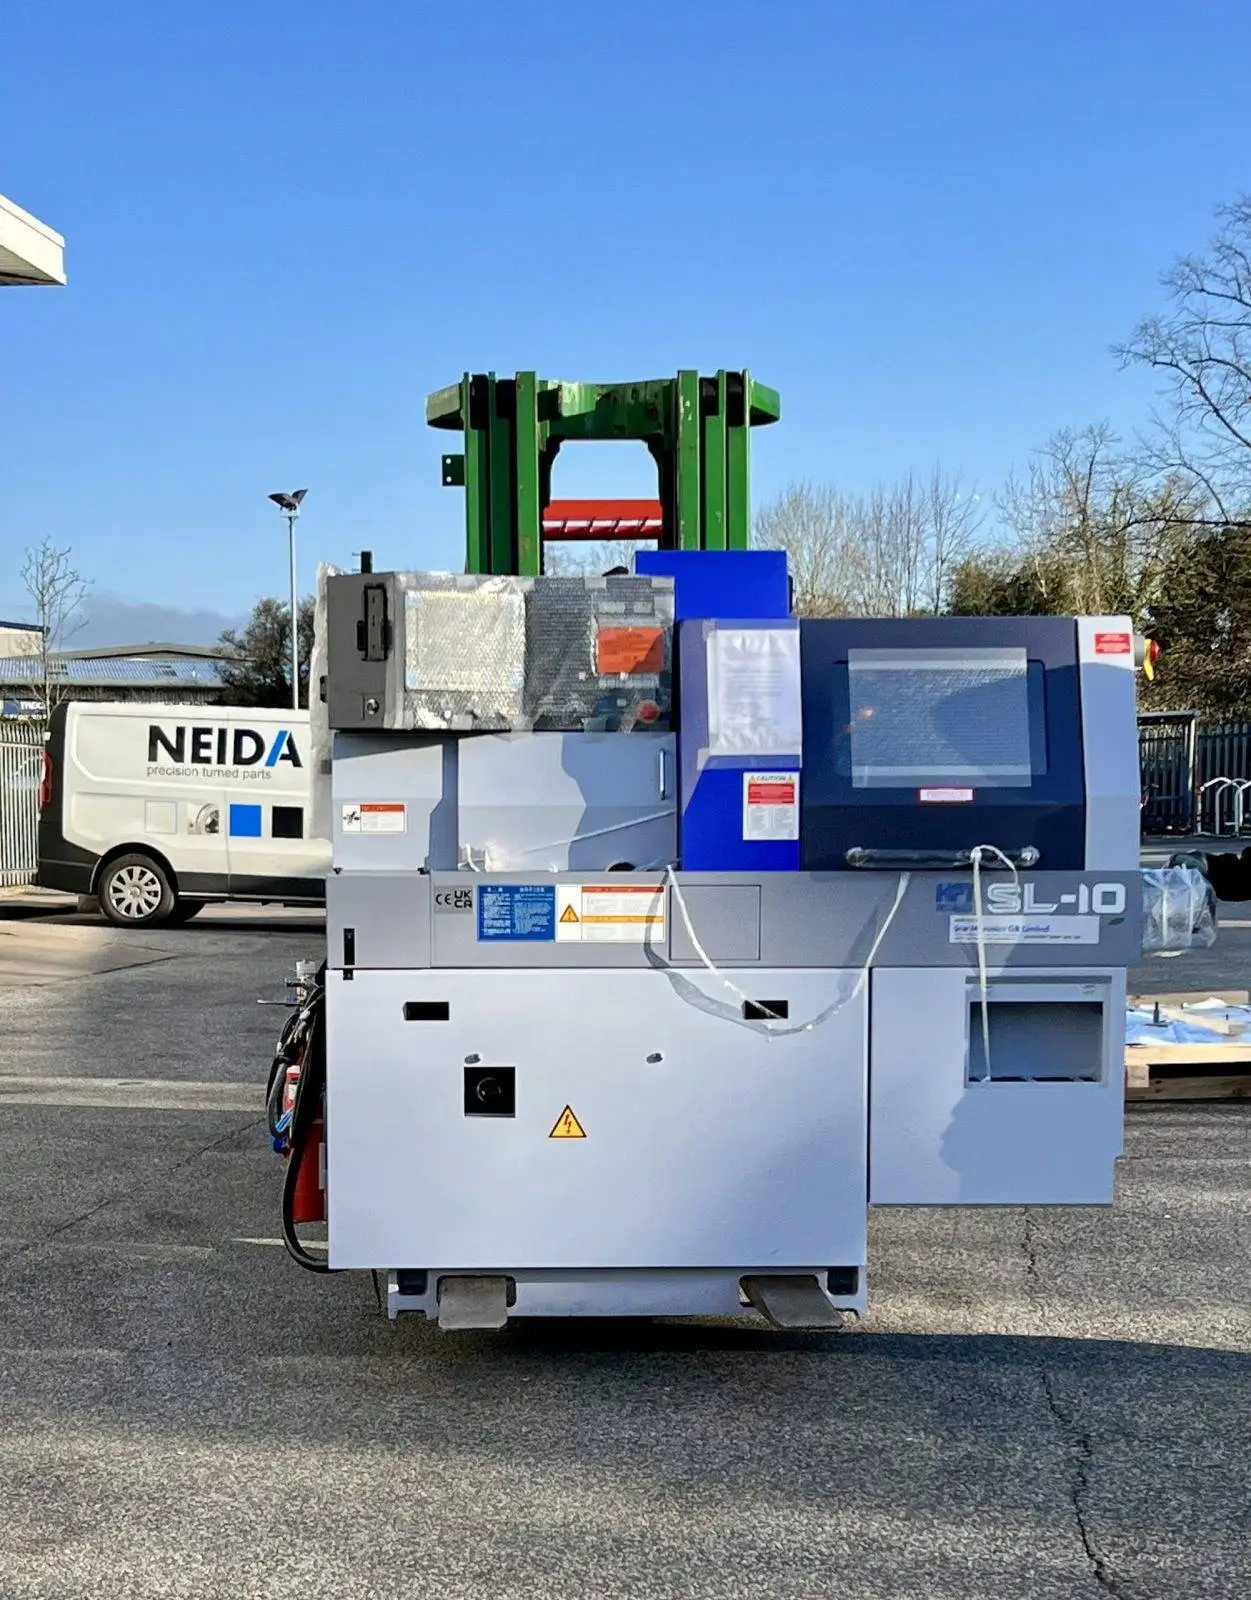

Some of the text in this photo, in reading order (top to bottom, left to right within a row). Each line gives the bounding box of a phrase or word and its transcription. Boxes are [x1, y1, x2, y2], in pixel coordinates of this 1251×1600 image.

[148, 725, 303, 768] NEIDA
[147, 766, 272, 780] precision turned parts
[454, 889, 472, 899] UK
[987, 882, 1126, 914] SL-10
[454, 899, 472, 909] CA
